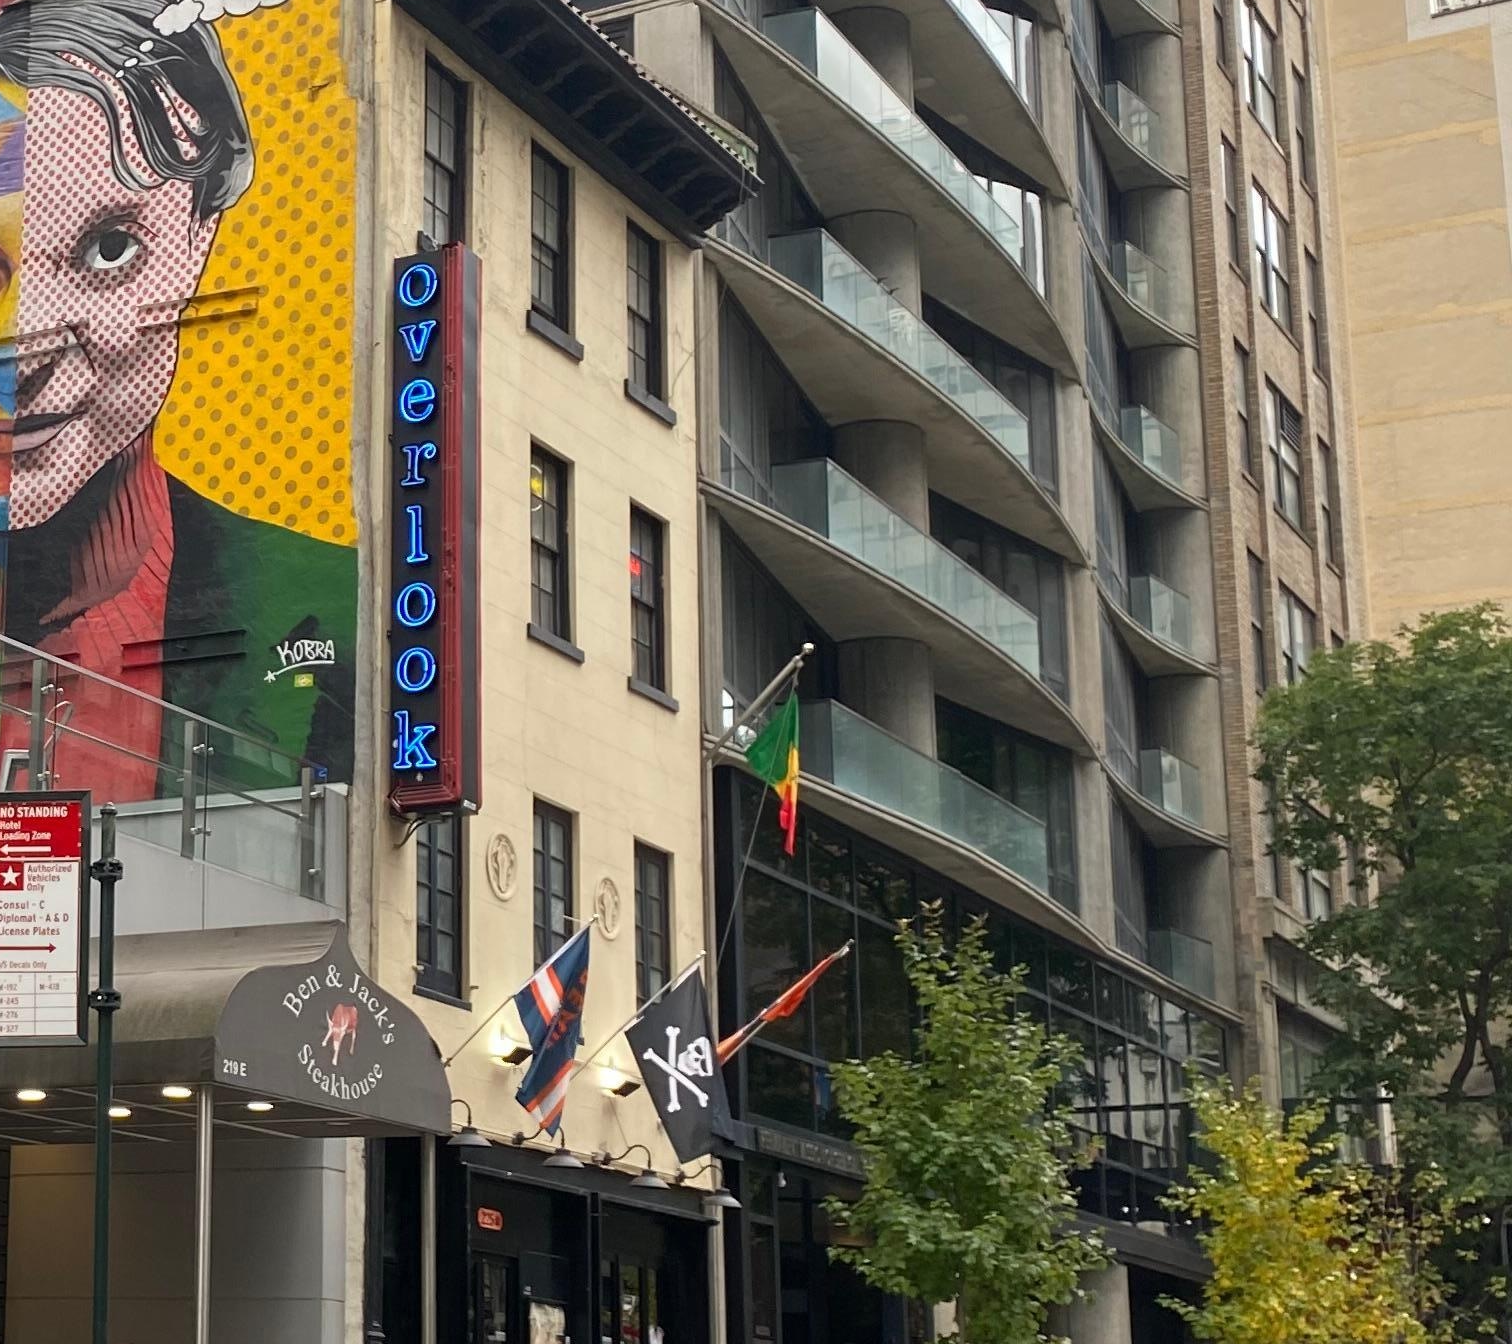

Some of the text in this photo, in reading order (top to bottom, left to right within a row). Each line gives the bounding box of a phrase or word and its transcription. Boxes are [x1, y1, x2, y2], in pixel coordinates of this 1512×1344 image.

[276, 639, 335, 666] KOBRA
[0, 806, 68, 818] NO STANDING
[0, 820, 21, 830] Hotel
[0, 830, 51, 842] Loading Zone
[27, 864, 72, 873] Authorized
[27, 873, 60, 882] Vehicles
[26, 882, 45, 893] Only
[39, 900, 45, 910] C
[45, 913, 51, 922] A
[53, 913, 60, 922] &
[62, 913, 69, 922] D
[32, 926, 61, 936] Plates
[9, 960, 31, 969] Decals
[32, 960, 47, 970] Only
[281, 964, 395, 1045] Ben & Jack's
[223, 1059, 248, 1077] 219 E
[298, 1044, 383, 1100] Steakhouse
